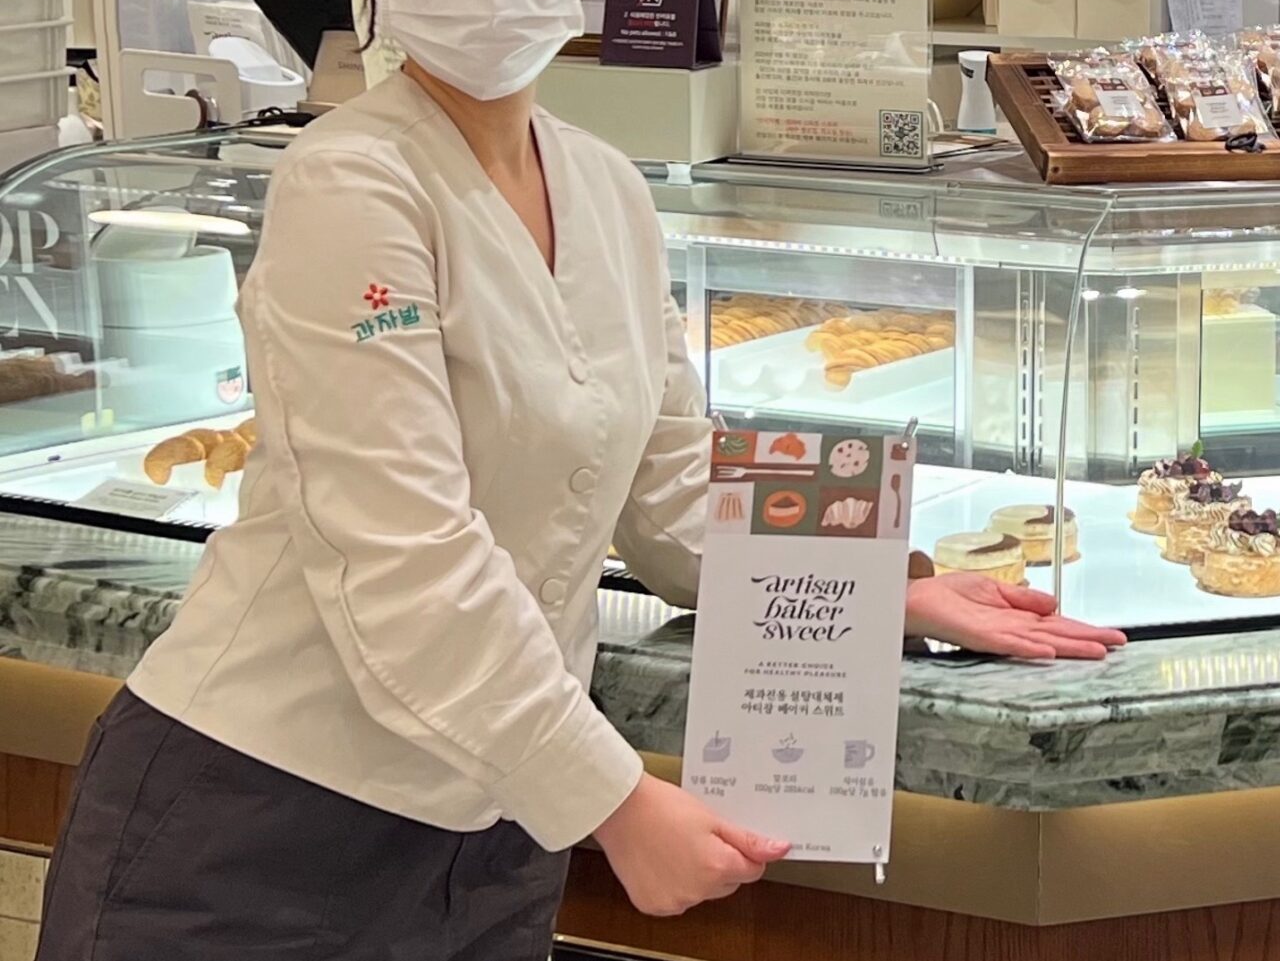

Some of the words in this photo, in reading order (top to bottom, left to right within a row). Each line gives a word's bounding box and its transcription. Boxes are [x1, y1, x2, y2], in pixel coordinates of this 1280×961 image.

[350, 302, 419, 343] 과자방
[751, 573, 856, 603] artisan
[764, 595, 844, 621] baker
[752, 620, 853, 642] sweet
